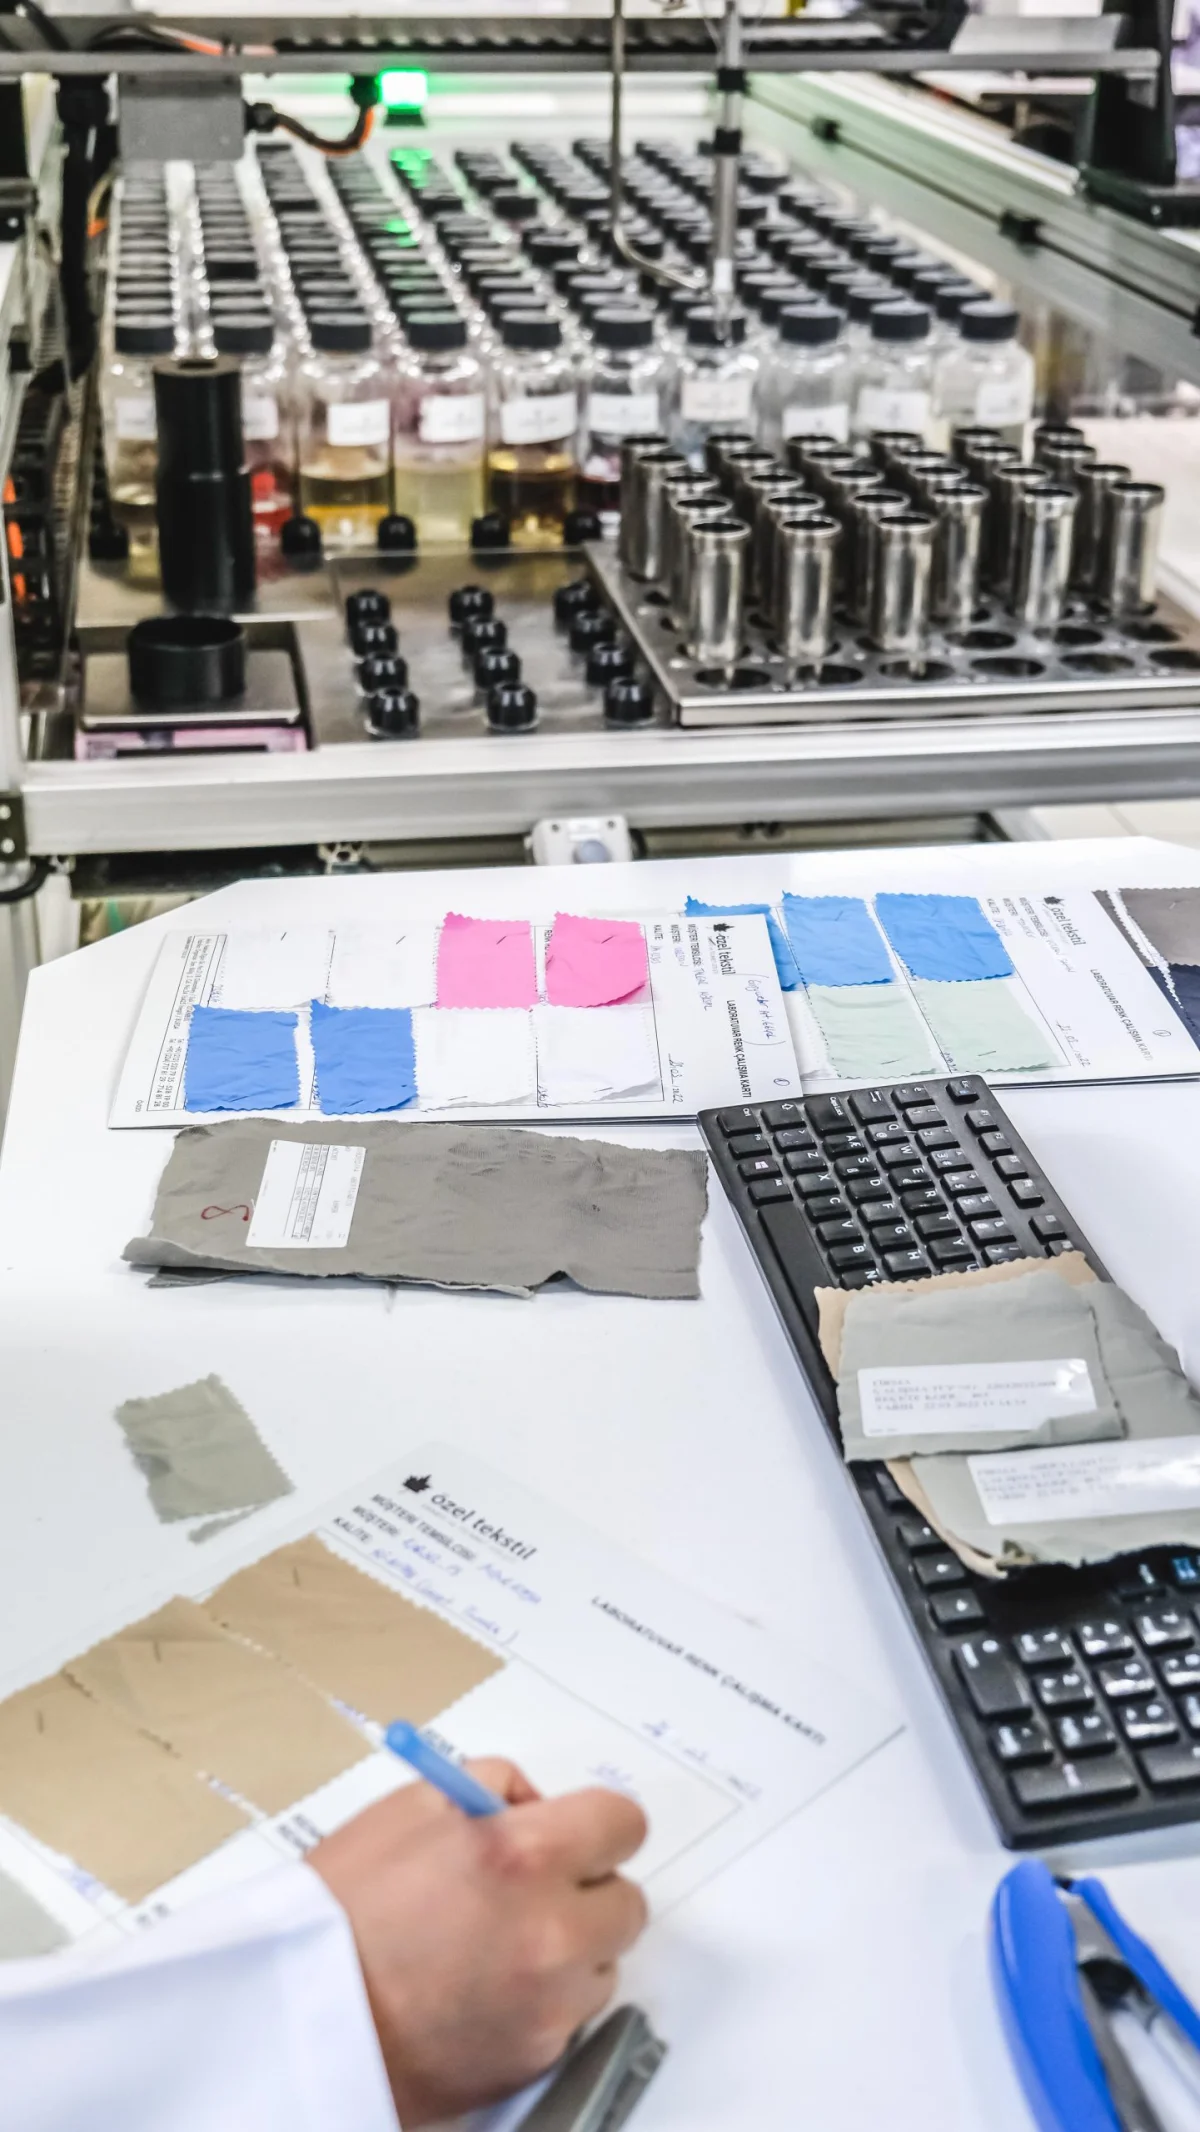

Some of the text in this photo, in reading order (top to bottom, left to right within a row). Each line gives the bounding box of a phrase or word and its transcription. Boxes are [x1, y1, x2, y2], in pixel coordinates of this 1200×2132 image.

[1052, 907, 1070, 925] özel
[1062, 923, 1086, 946] tekstil
[716, 935, 736, 975] özel tekstil
[1091, 969, 1119, 1007] LABORATUVAR
[1113, 1005, 1129, 1023] RENK
[1121, 1020, 1142, 1046] ÇALIŞMA
[727, 1000, 751, 1098] LABORATUVAR RENK ÇALIŞMA KARTI
[888, 1123, 900, 1132] Q
[901, 1145, 913, 1154] W
[818, 1173, 831, 1182] X
[870, 1179, 882, 1187] D
[925, 1190, 937, 1198] R
[830, 1197, 841, 1205] C
[882, 1202, 895, 1210] F
[939, 1213, 951, 1221] T
[894, 1227, 907, 1235] G
[852, 1245, 865, 1254] B
[907, 1251, 921, 1260] H
[865, 1269, 879, 1280] N
[431, 1493, 476, 1523] özel
[472, 1518, 538, 1560] tekstil
[592, 1596, 684, 1656] LABORATUVAR
